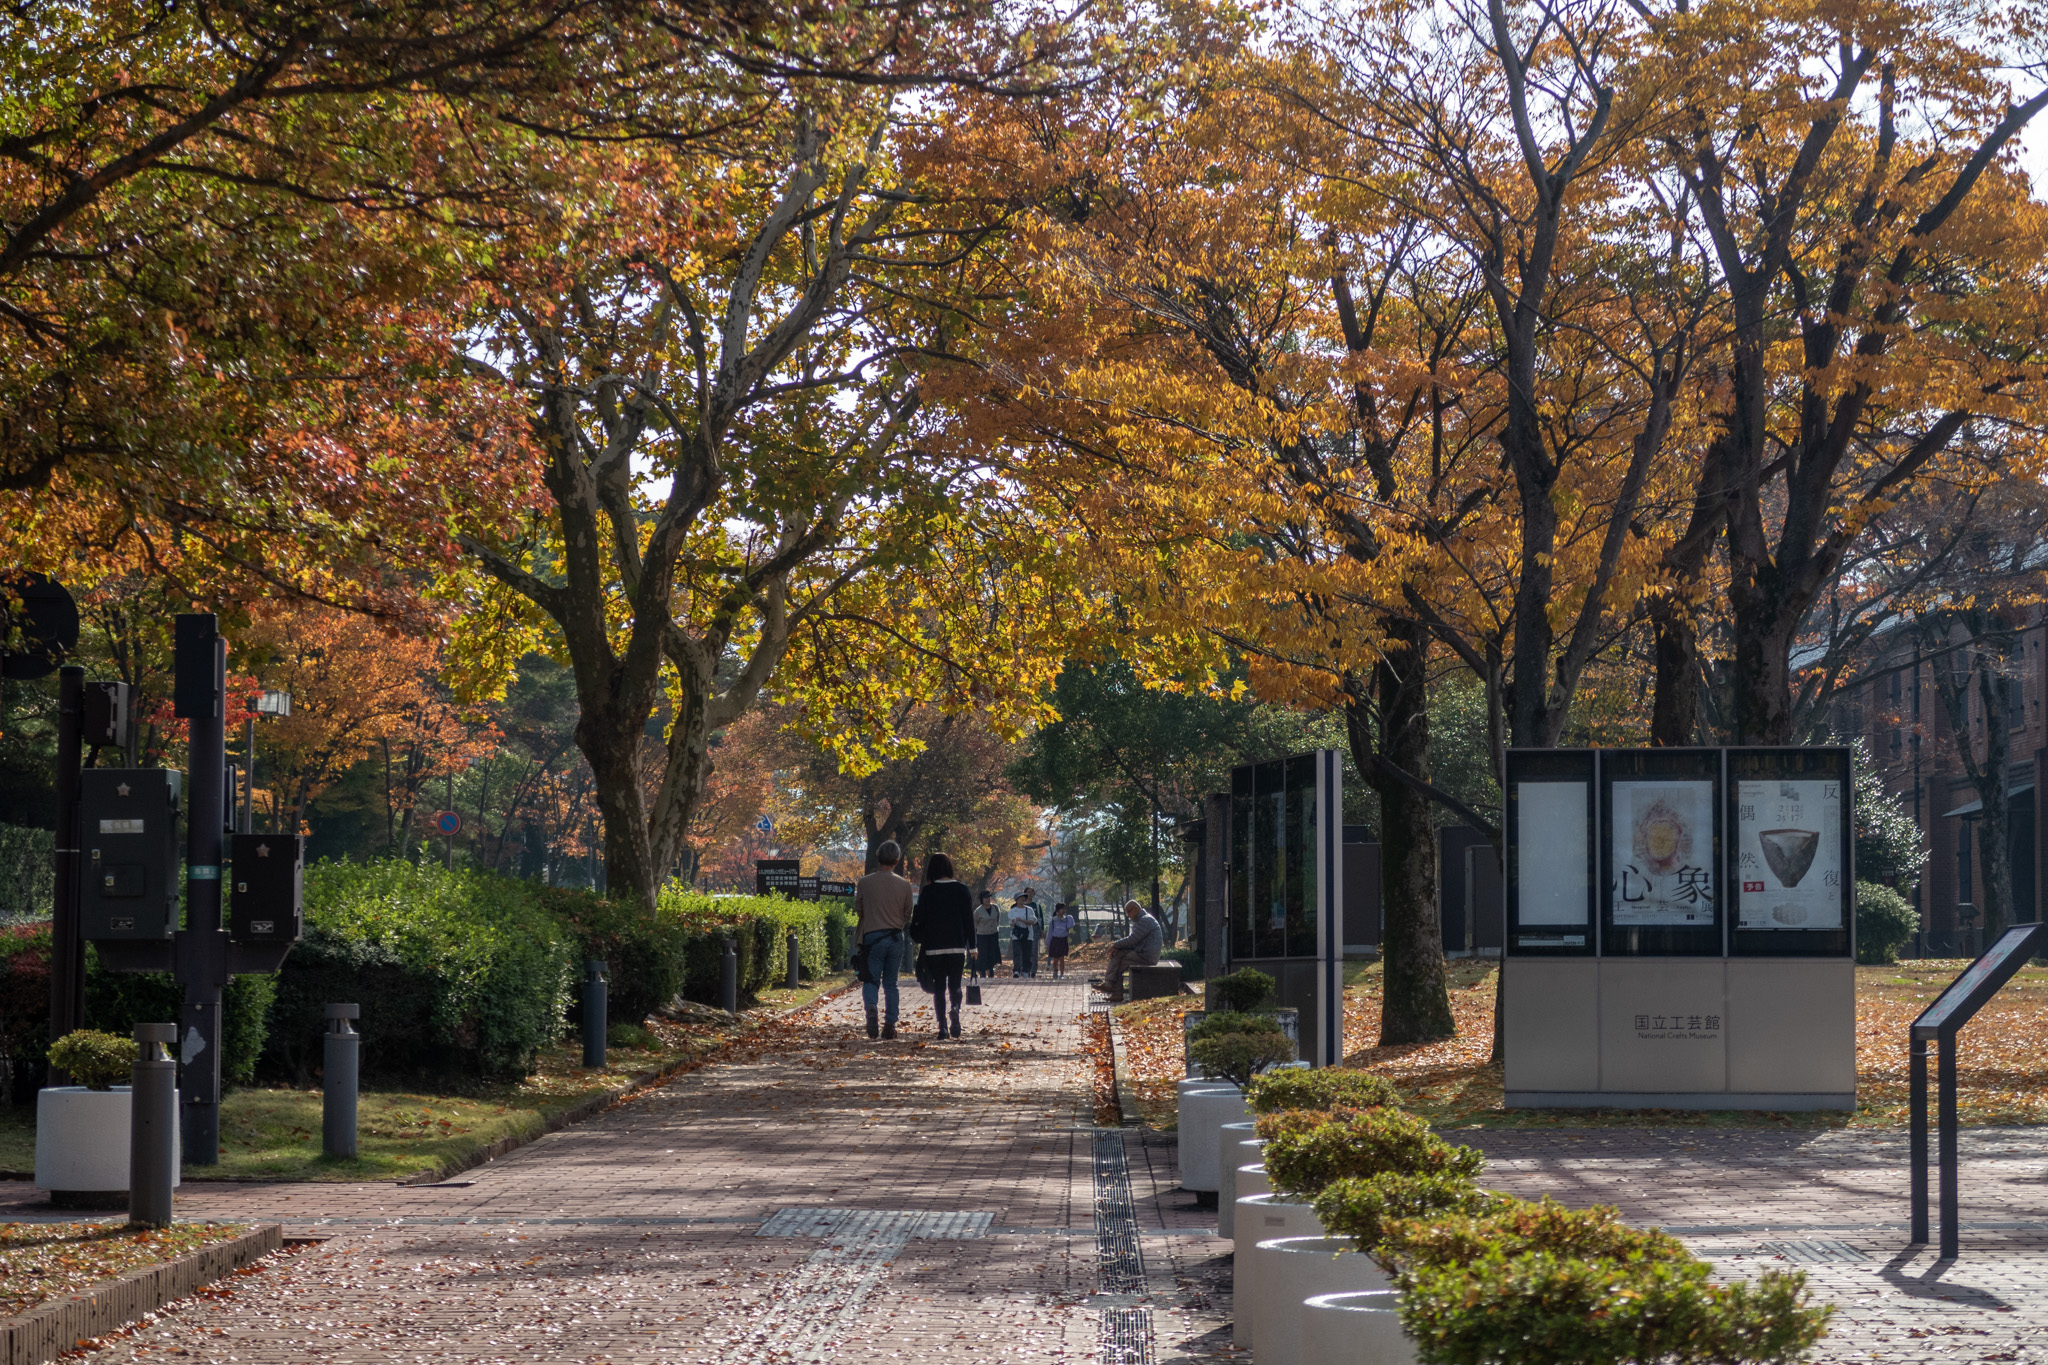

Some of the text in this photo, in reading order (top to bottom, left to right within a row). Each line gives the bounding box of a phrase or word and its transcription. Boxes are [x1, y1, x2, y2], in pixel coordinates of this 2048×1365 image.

[1824, 783, 1839, 800] 反
[1740, 804, 1755, 821] 偶
[1612, 864, 1713, 904] 心象
[1746, 882, 1762, 891] 予告
[1824, 870, 1839, 887] 復
[820, 884, 845, 893] お手洗い
[1635, 1015, 1720, 1030] 国立工芸館
